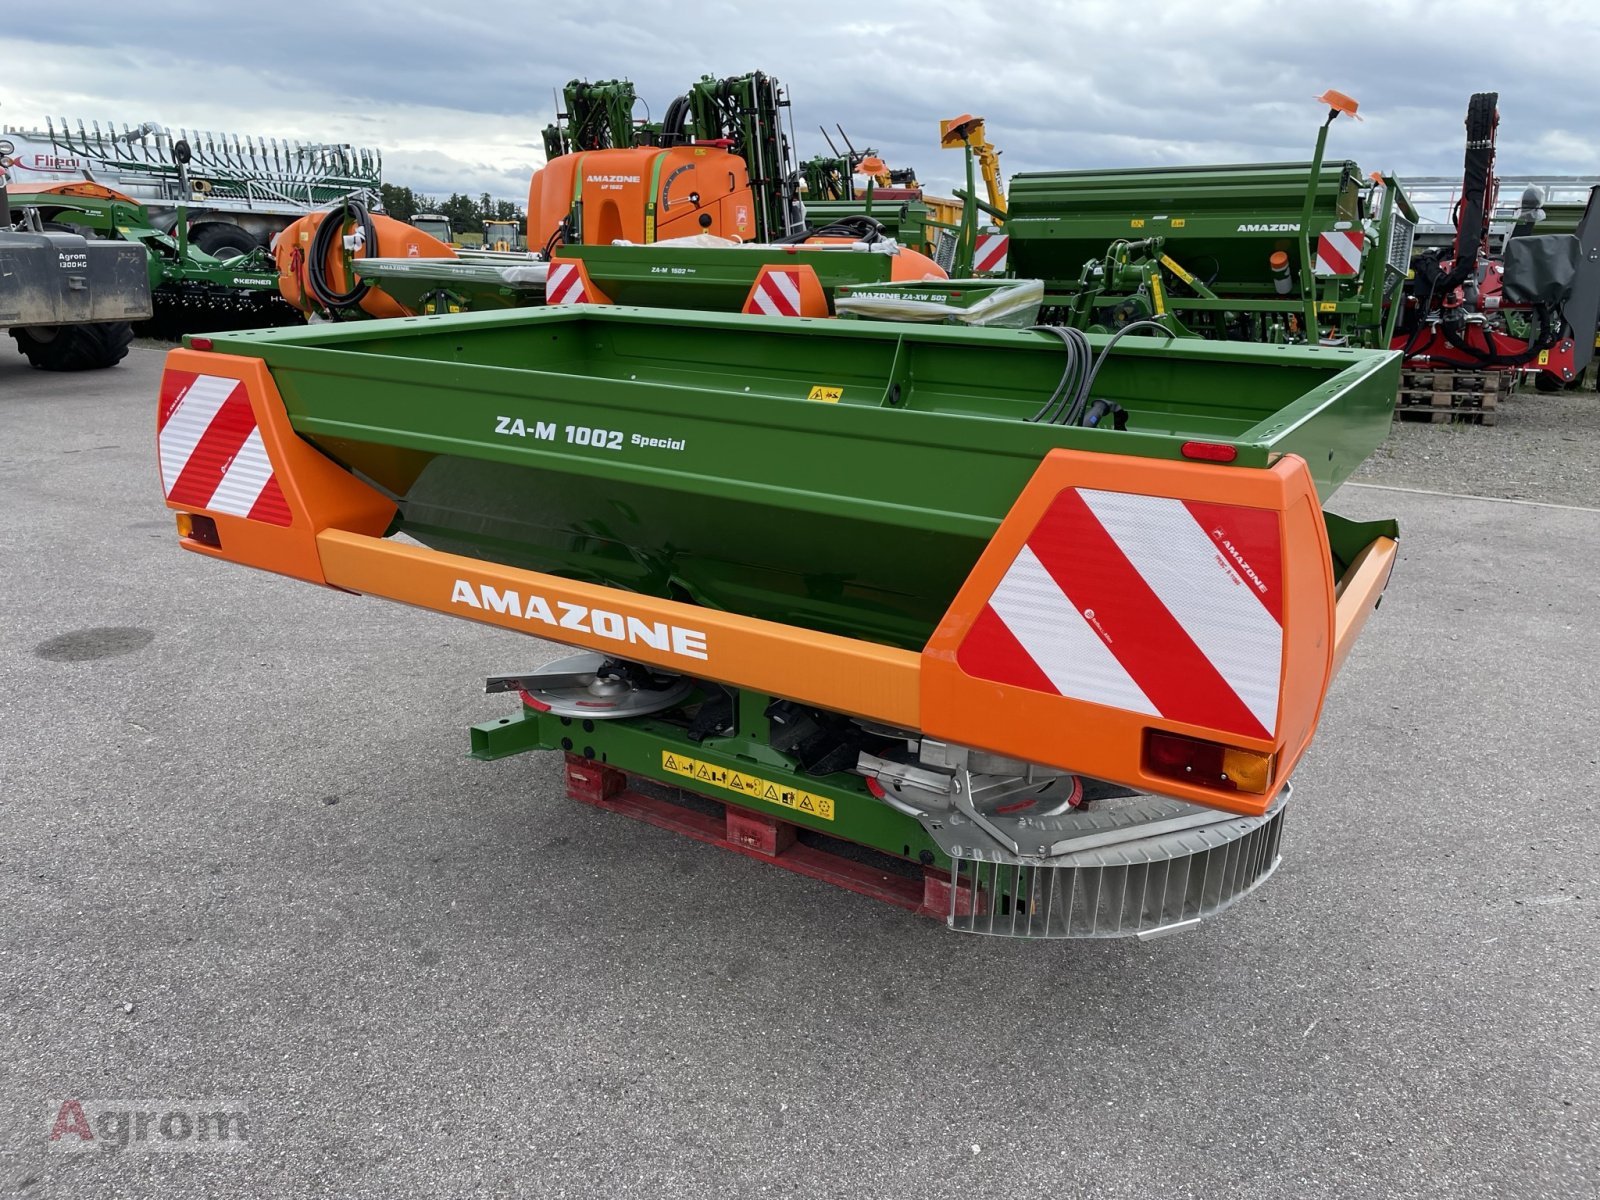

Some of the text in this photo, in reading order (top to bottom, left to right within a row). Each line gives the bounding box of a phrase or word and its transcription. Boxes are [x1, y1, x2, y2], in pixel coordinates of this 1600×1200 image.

[587, 175, 641, 183] AMAZONE
[1237, 223, 1301, 232] AMAZON
[59, 252, 87, 262] Agrom
[240, 278, 272, 286] KERNER
[851, 291, 948, 302] AMAZONE ZA-XW 503
[494, 416, 686, 451] ZA-M 1002 Special
[1222, 540, 1269, 594] AMAZONE
[451, 579, 709, 661] AMAZONE
